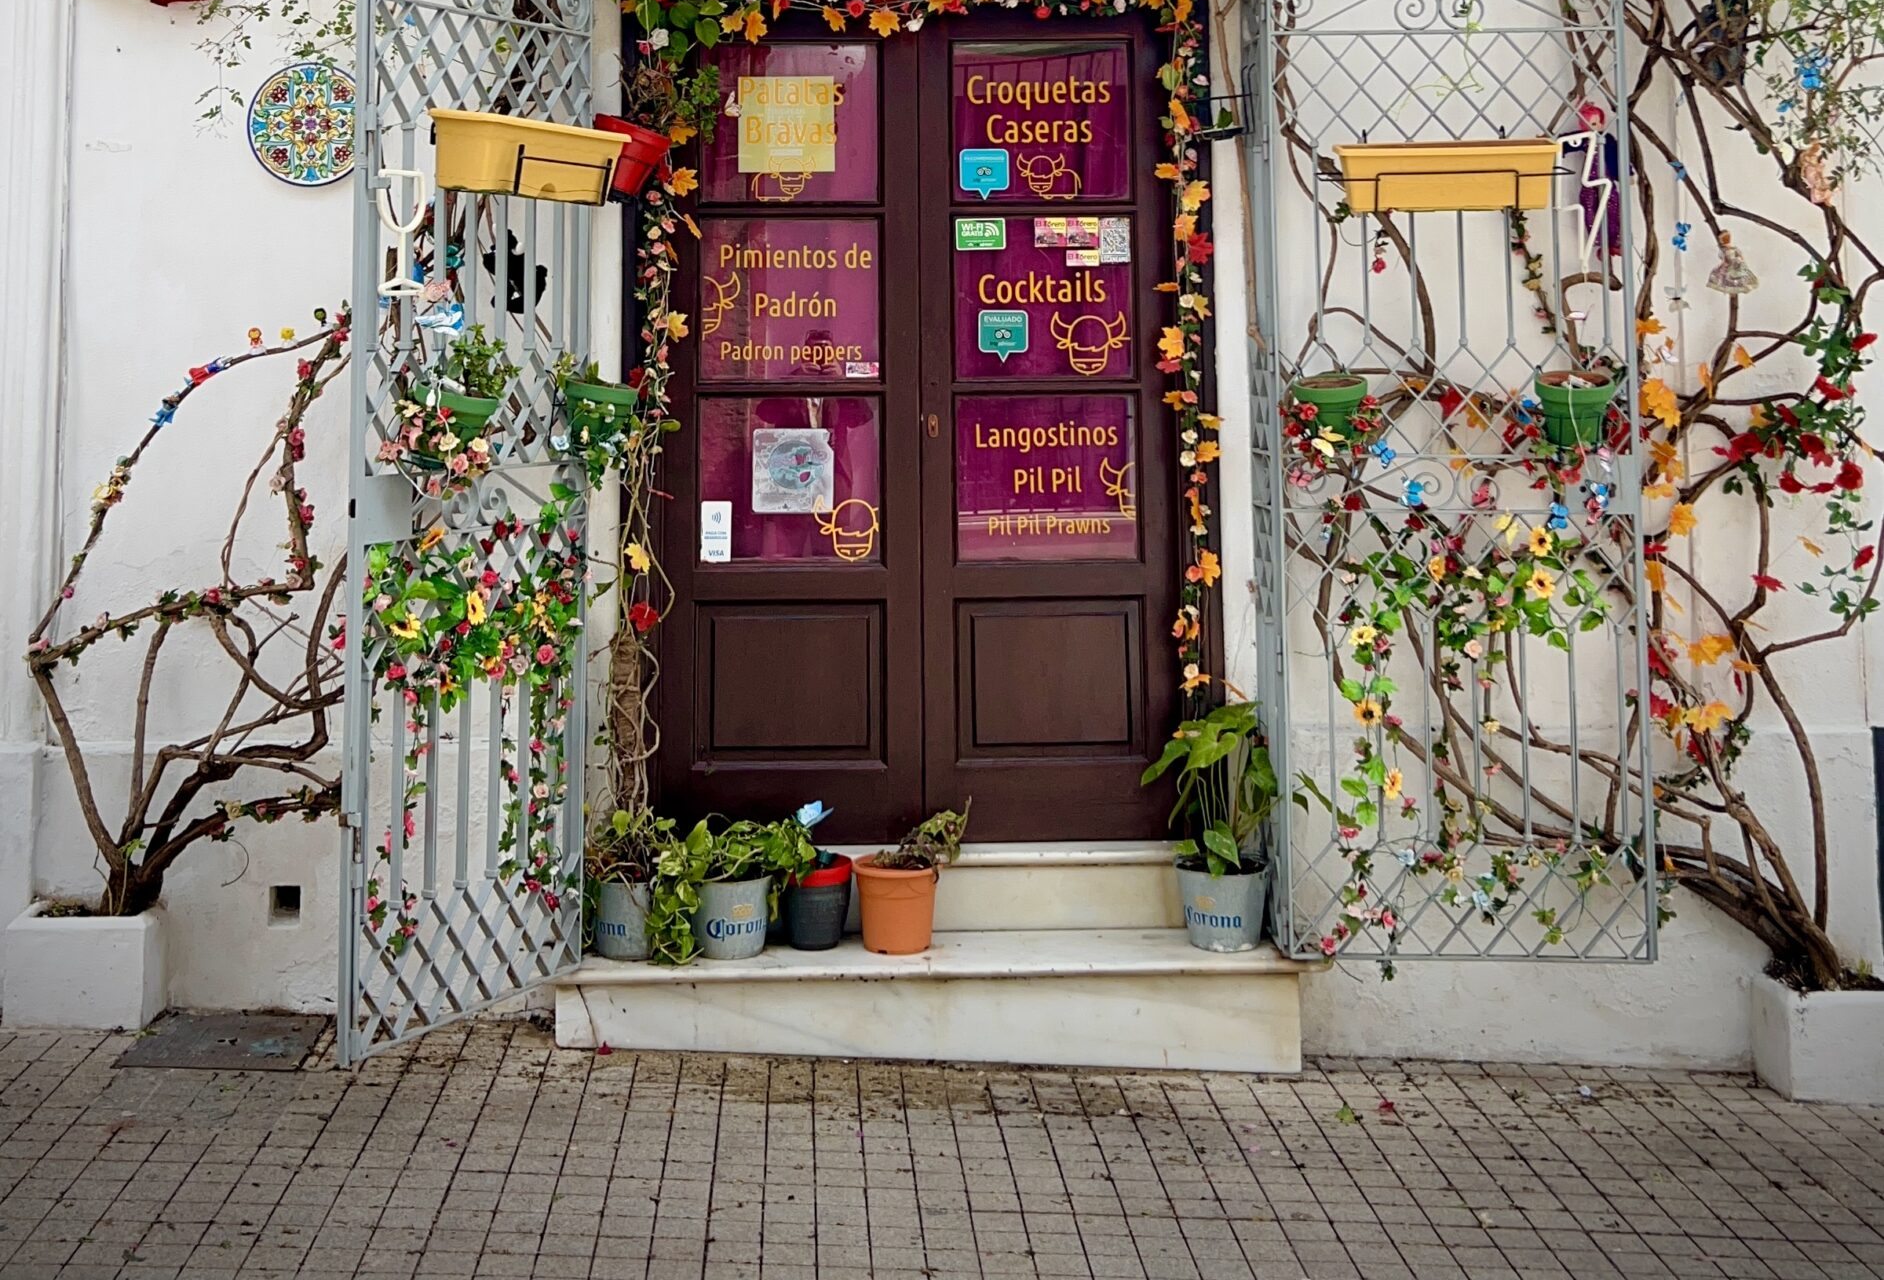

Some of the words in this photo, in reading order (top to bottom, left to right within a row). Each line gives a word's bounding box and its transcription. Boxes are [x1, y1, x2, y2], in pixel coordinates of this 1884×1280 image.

[739, 78, 845, 106] Patatas
[967, 75, 1111, 111] Croquetas
[746, 116, 837, 145] Bravas
[986, 114, 1093, 144] Caseras
[720, 243, 837, 269] Pimientos
[844, 242, 872, 269] de
[978, 270, 1107, 304] Cocktails
[755, 291, 837, 318] Padrón
[983, 315, 1023, 323] EVALUADO
[720, 340, 784, 361] Padron
[790, 344, 862, 365] peppers
[975, 421, 1118, 453] Langostinos
[1014, 467, 1044, 494] Pil
[1052, 466, 1082, 493] Pil
[988, 517, 1012, 536] Pil
[1017, 515, 1040, 536] Pil
[1046, 517, 1111, 535] Prawns
[708, 549, 725, 557] VISA
[599, 921, 626, 937] ona
